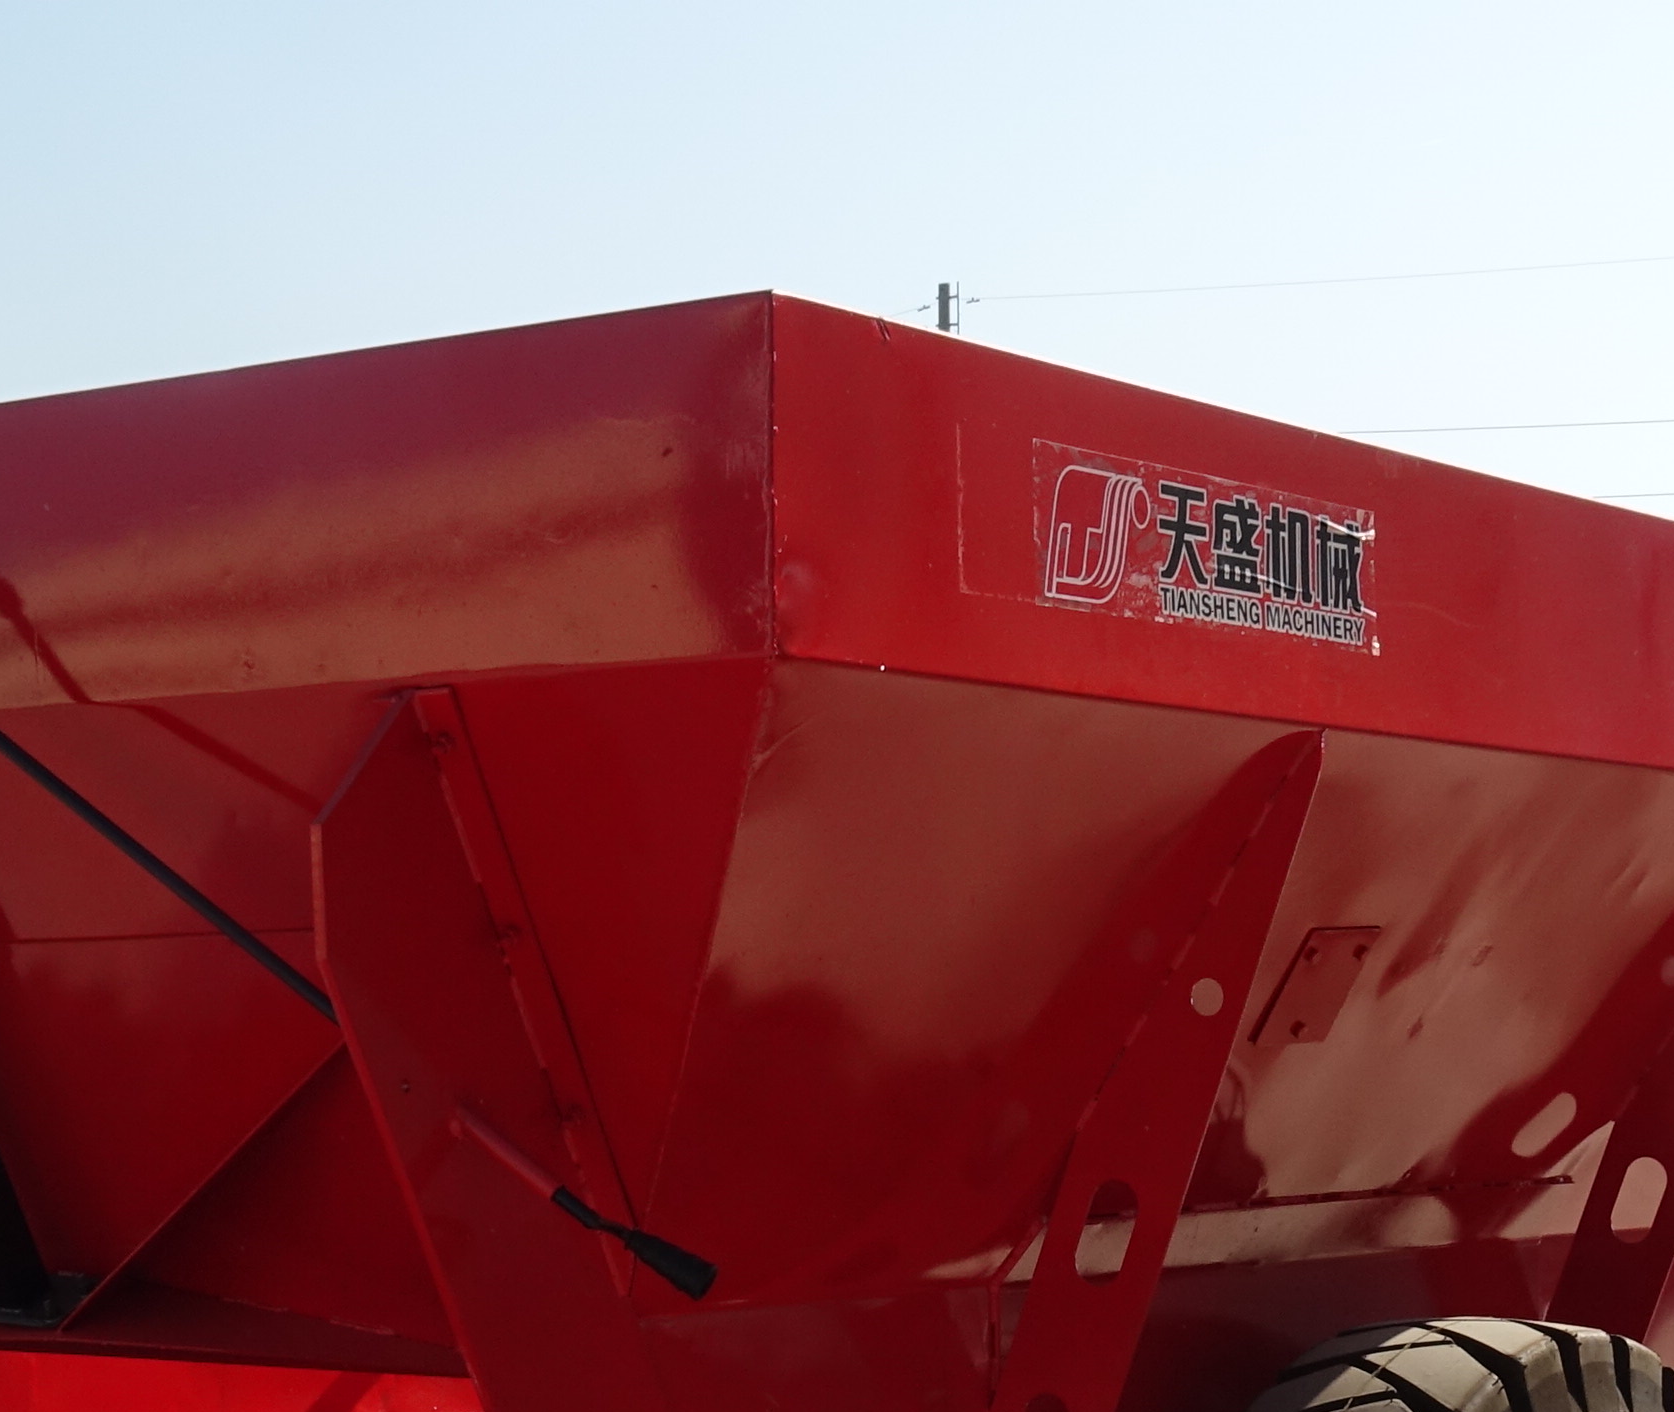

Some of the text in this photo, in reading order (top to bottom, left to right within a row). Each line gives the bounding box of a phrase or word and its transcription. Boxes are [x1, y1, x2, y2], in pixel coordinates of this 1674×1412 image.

[1158, 482, 1363, 613] 天盛机械
[1160, 585, 1364, 643] TIANSHENG MACHINERY
